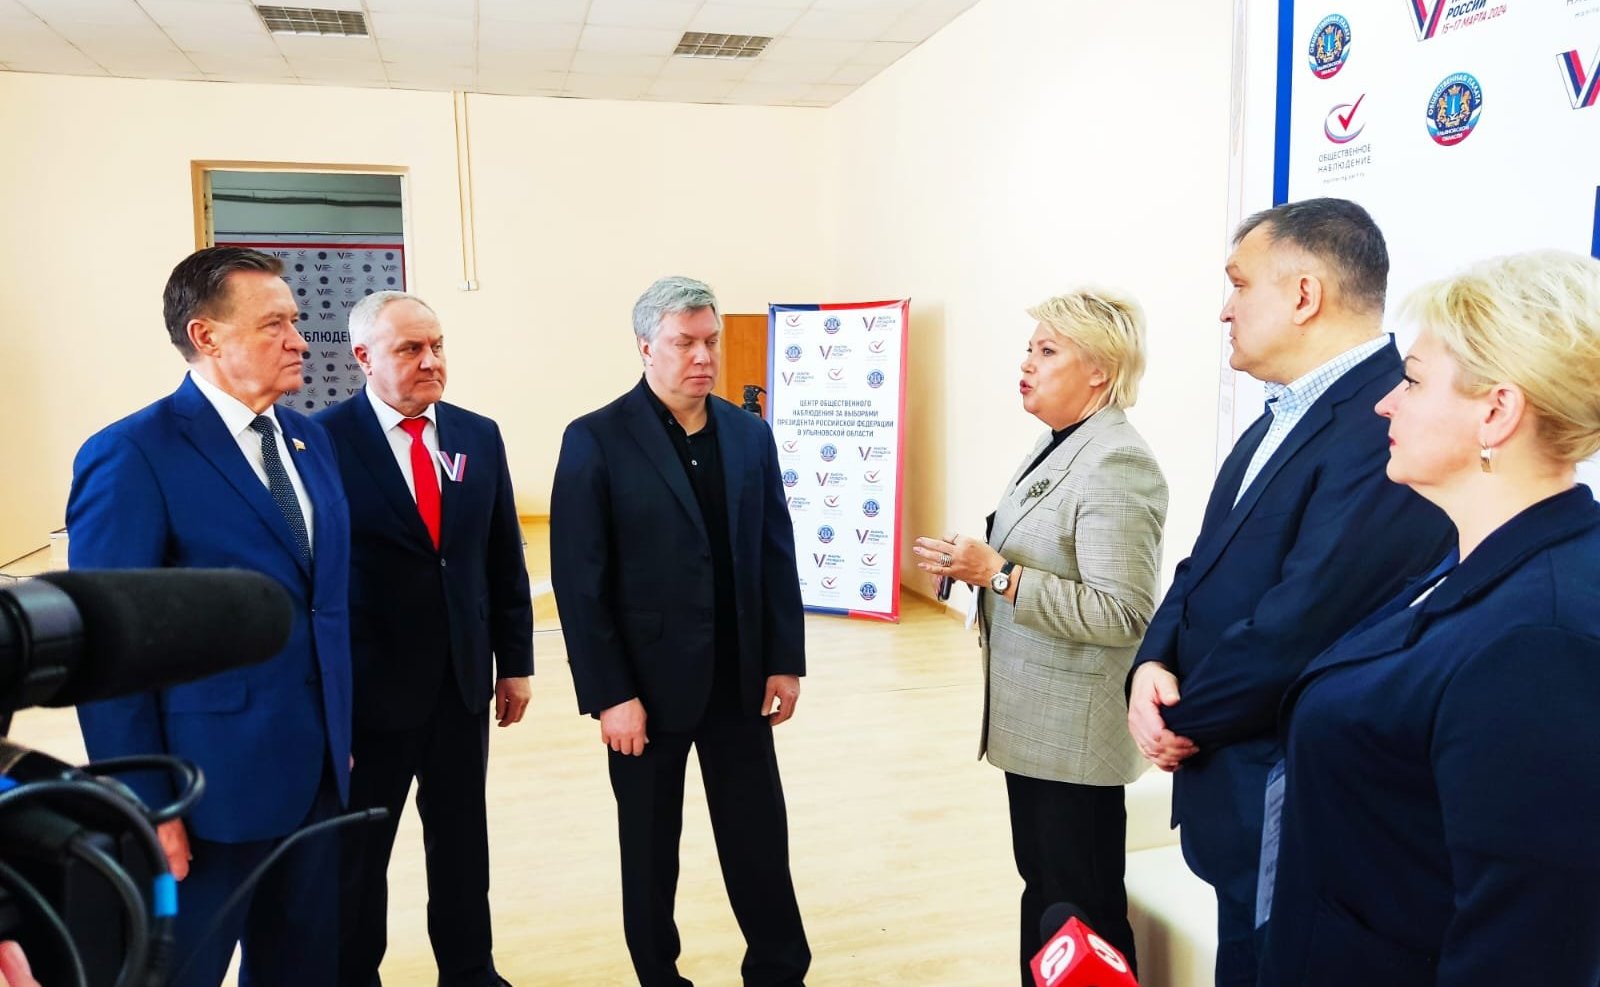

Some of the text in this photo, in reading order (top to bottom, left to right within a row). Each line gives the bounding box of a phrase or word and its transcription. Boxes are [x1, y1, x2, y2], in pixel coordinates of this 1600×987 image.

[1446, 0, 1487, 20] РОССИИ
[1462, 11, 1487, 27] МАРТА
[1318, 143, 1372, 163] ОБЩЕСТВЕННОЕ
[1317, 155, 1373, 173] НАБЛЮДЕНИЕ
[799, 399, 872, 407] ЦЕНТР ОБЩЕСТВЕННОГО
[792, 409, 879, 418] НАБЛЮДЕНИЯ ЗА ВЫБОРАМИ
[815, 418, 856, 427] РОССИЙСКОЙ
[856, 419, 894, 428] ФЕДЕРАЦИИ
[803, 428, 845, 437] УЛЬЯНОВСКОЙ
[846, 429, 874, 437] ОБЛАСТИ
